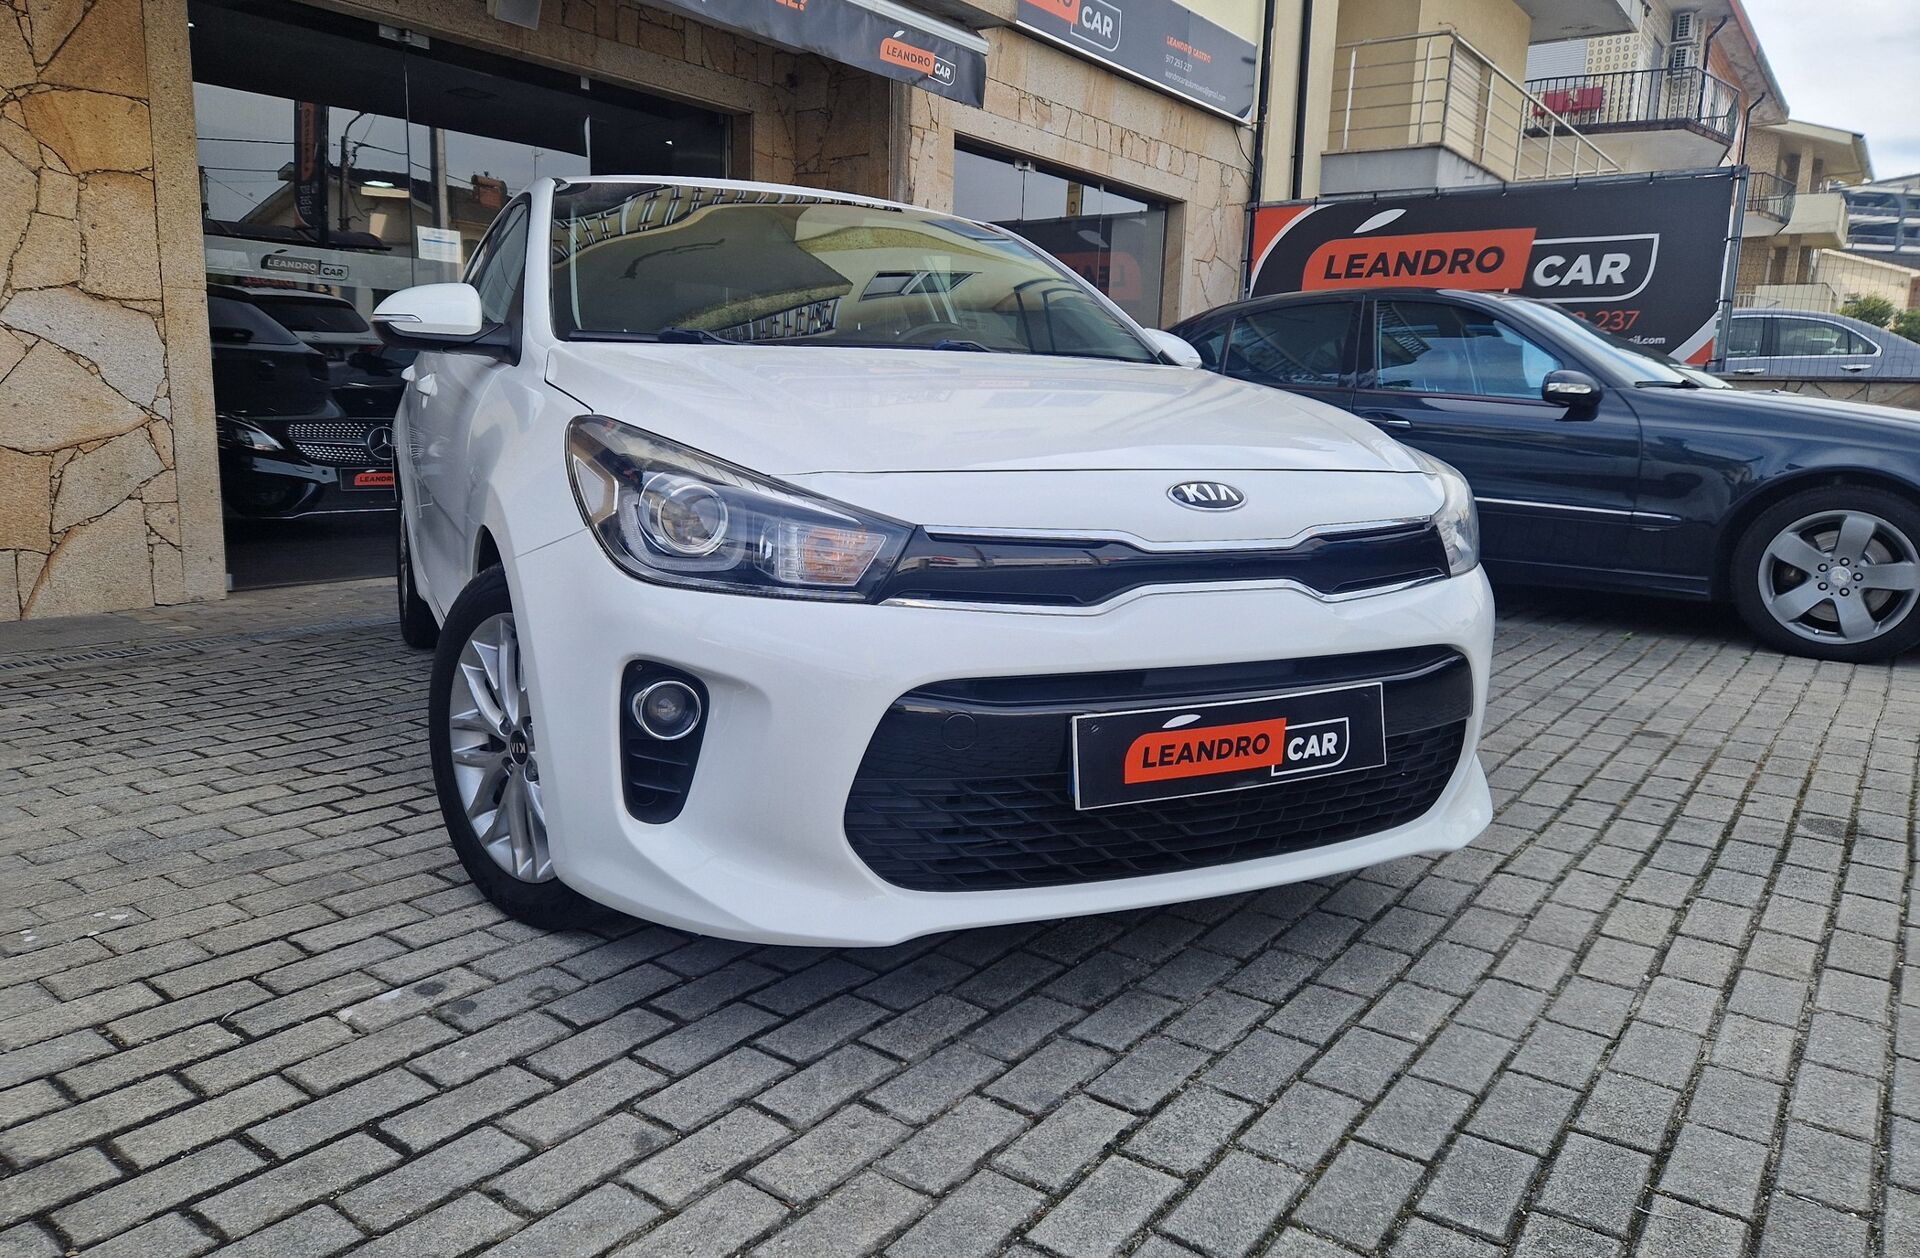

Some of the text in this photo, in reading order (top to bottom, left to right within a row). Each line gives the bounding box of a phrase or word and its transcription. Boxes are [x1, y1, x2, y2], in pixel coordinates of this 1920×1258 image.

[1081, 5, 1113, 39] CAR
[886, 44, 952, 80] LEANDRO CAR
[267, 258, 344, 277] LEANDRO CAR
[1322, 245, 1632, 288] LEANDRO CAR
[1596, 310, 1641, 331] 237
[360, 475, 394, 483] LEANDR
[1180, 483, 1239, 503] KIA
[1142, 732, 1338, 769] LEANDRO CAR
